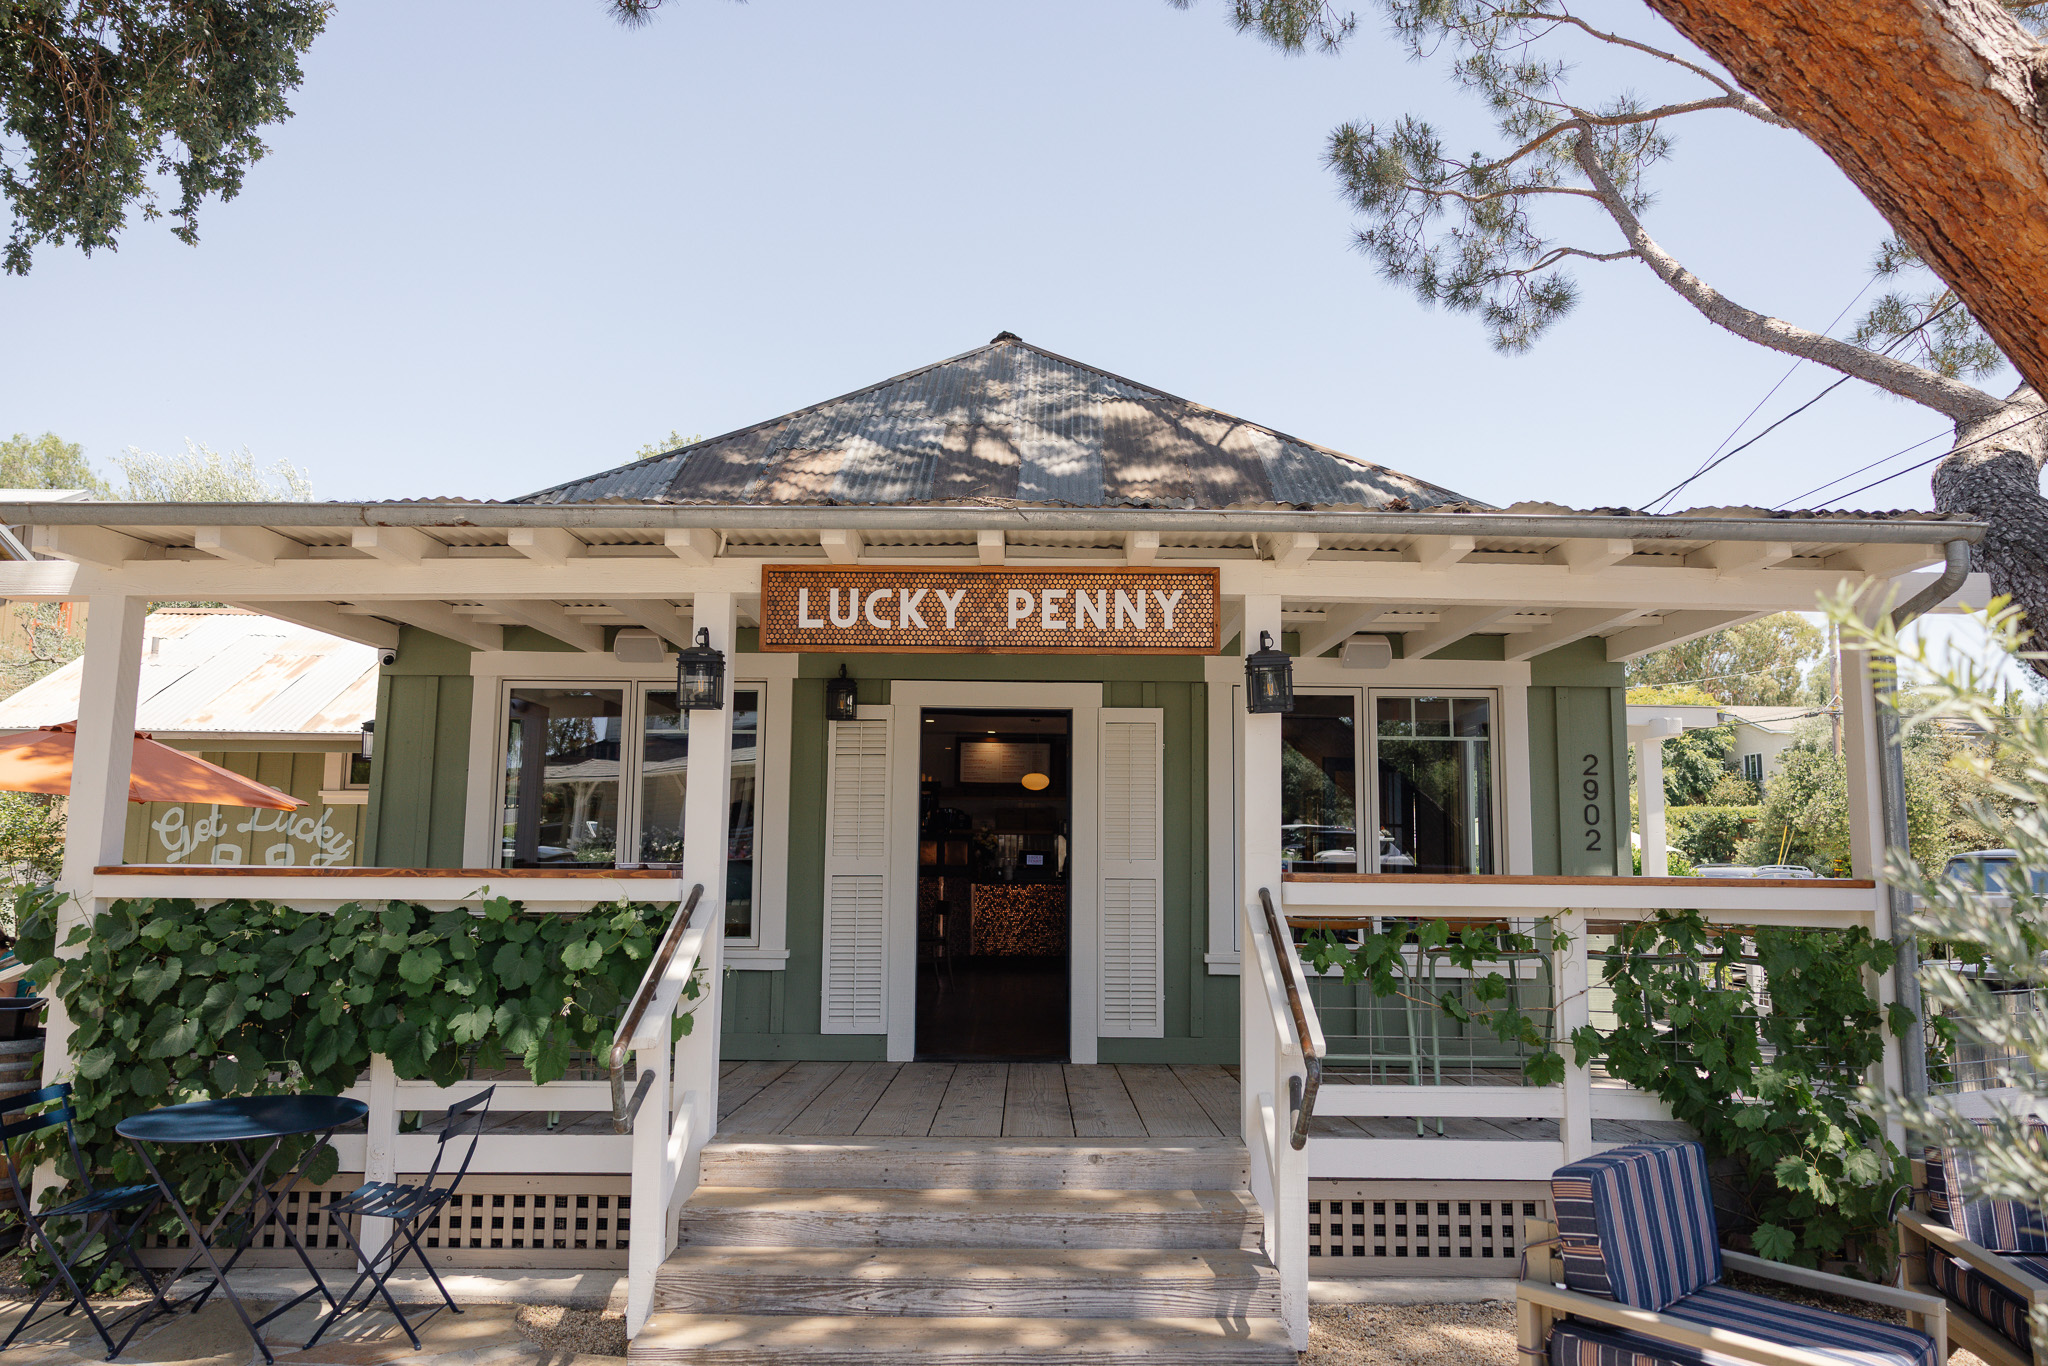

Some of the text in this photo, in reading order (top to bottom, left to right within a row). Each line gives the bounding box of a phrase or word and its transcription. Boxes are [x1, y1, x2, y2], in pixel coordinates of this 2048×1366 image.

[797, 587, 1185, 630] LUCKY PENNY
[151, 786, 354, 866] Get Lucky
[1582, 753, 1602, 851] 2902
